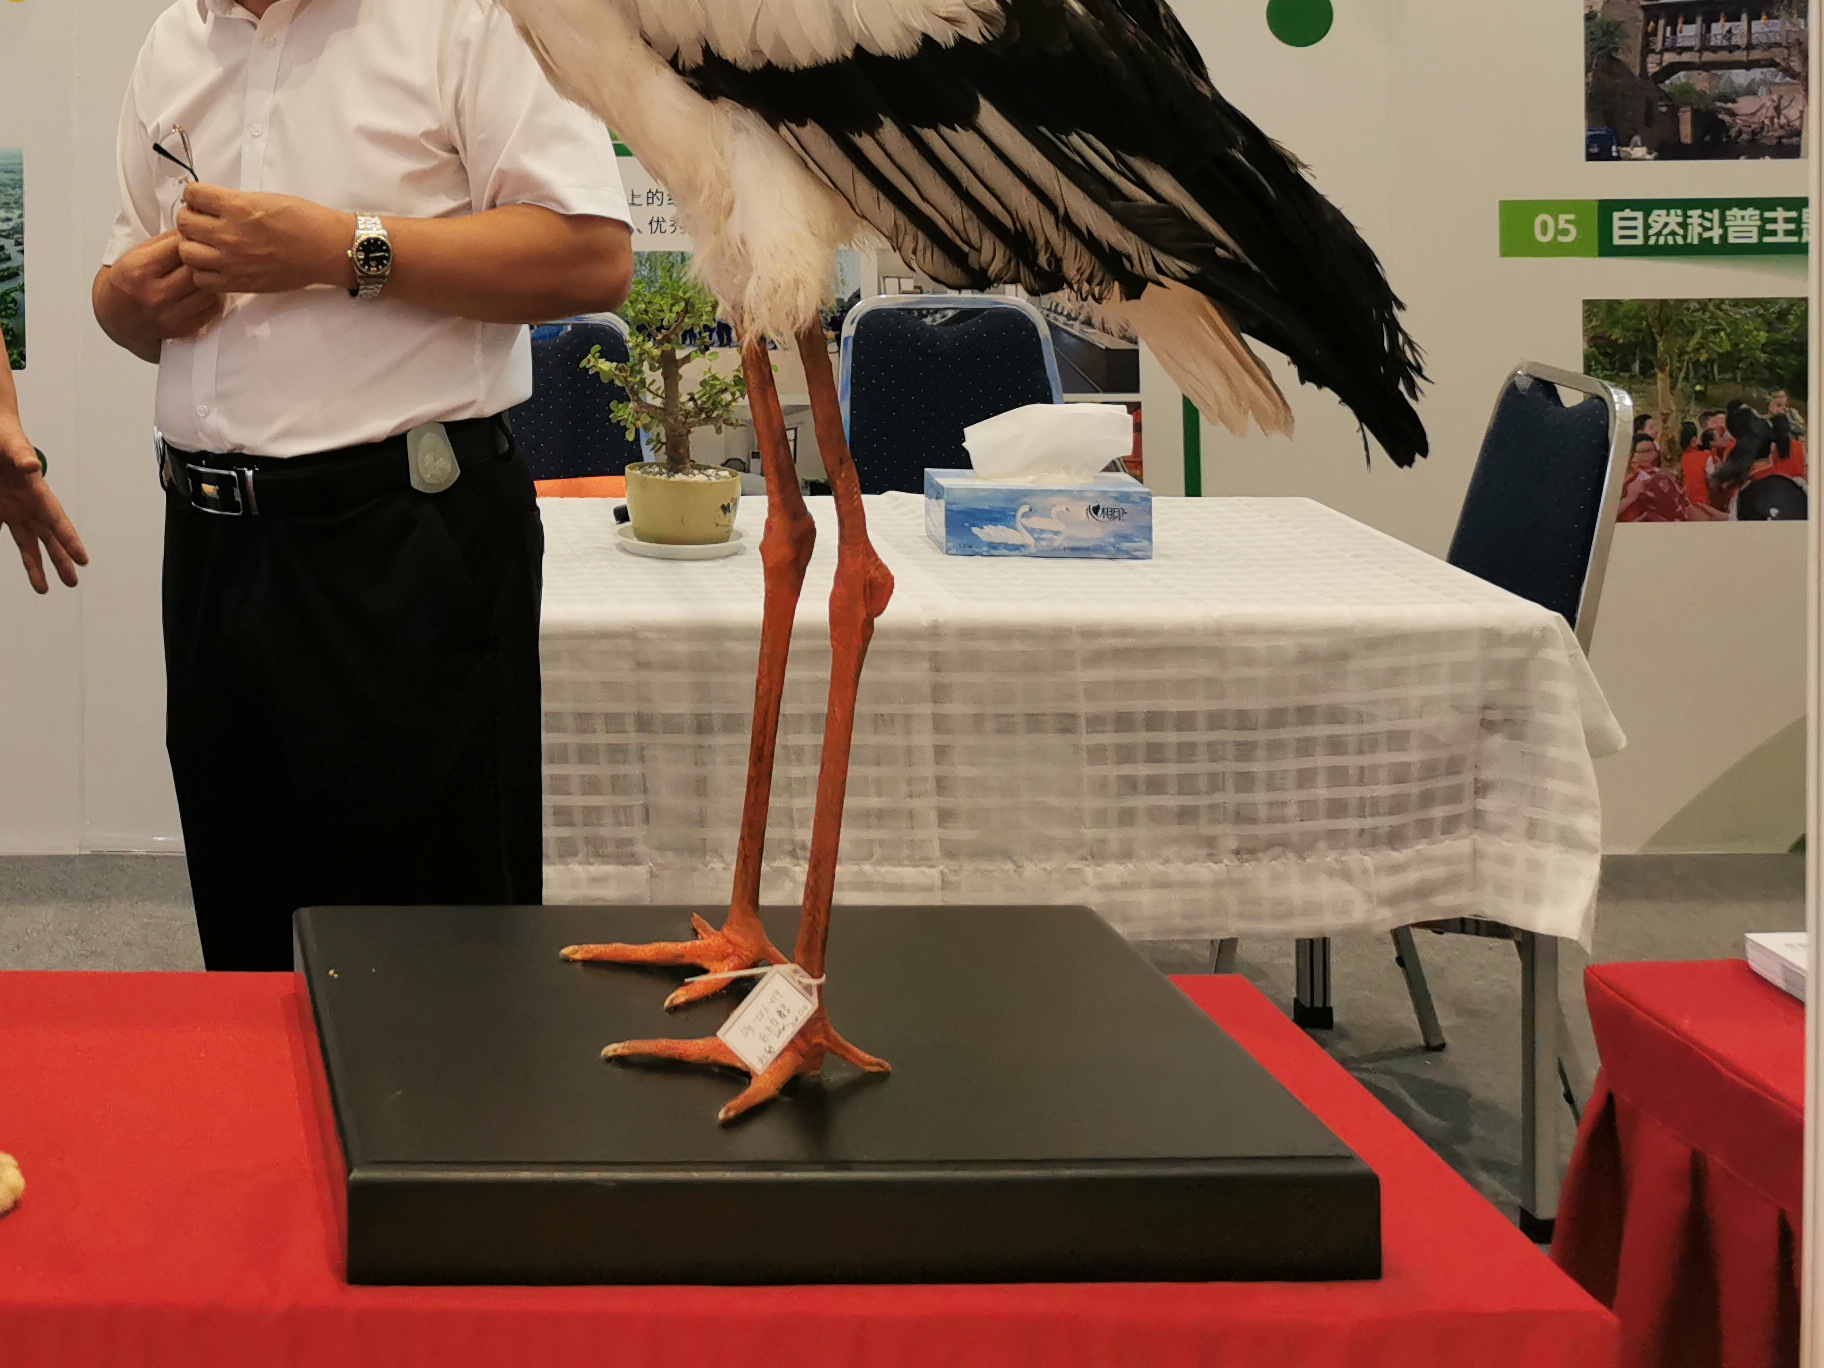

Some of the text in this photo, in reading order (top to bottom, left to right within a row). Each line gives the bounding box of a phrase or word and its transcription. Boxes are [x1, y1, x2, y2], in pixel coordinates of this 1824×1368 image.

[1533, 206, 1810, 245] 05 自然科普主
